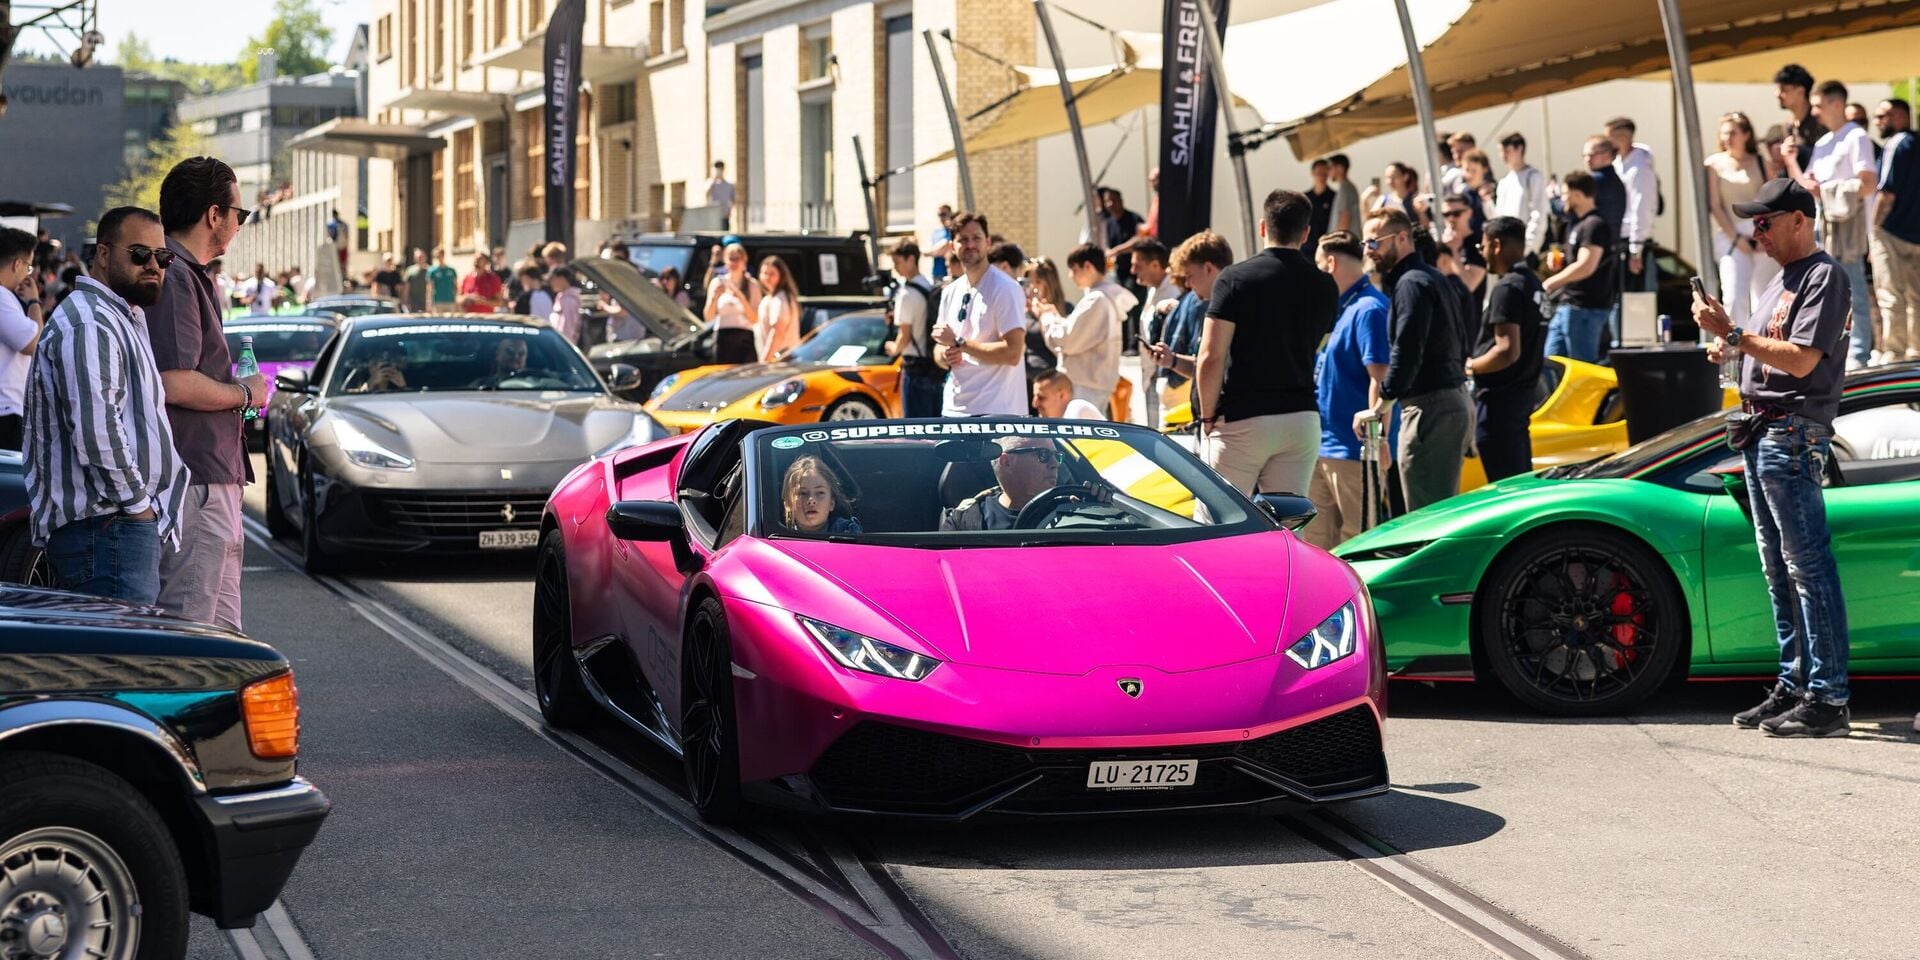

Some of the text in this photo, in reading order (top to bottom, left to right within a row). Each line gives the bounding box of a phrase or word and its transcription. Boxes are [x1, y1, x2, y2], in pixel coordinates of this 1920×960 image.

[552, 58, 566, 107] FREI
[1171, 2, 1198, 165] SAHLI & FREI
[551, 124, 565, 186] SAHLI
[831, 424, 1092, 439] SUPERCARLOVE.CH
